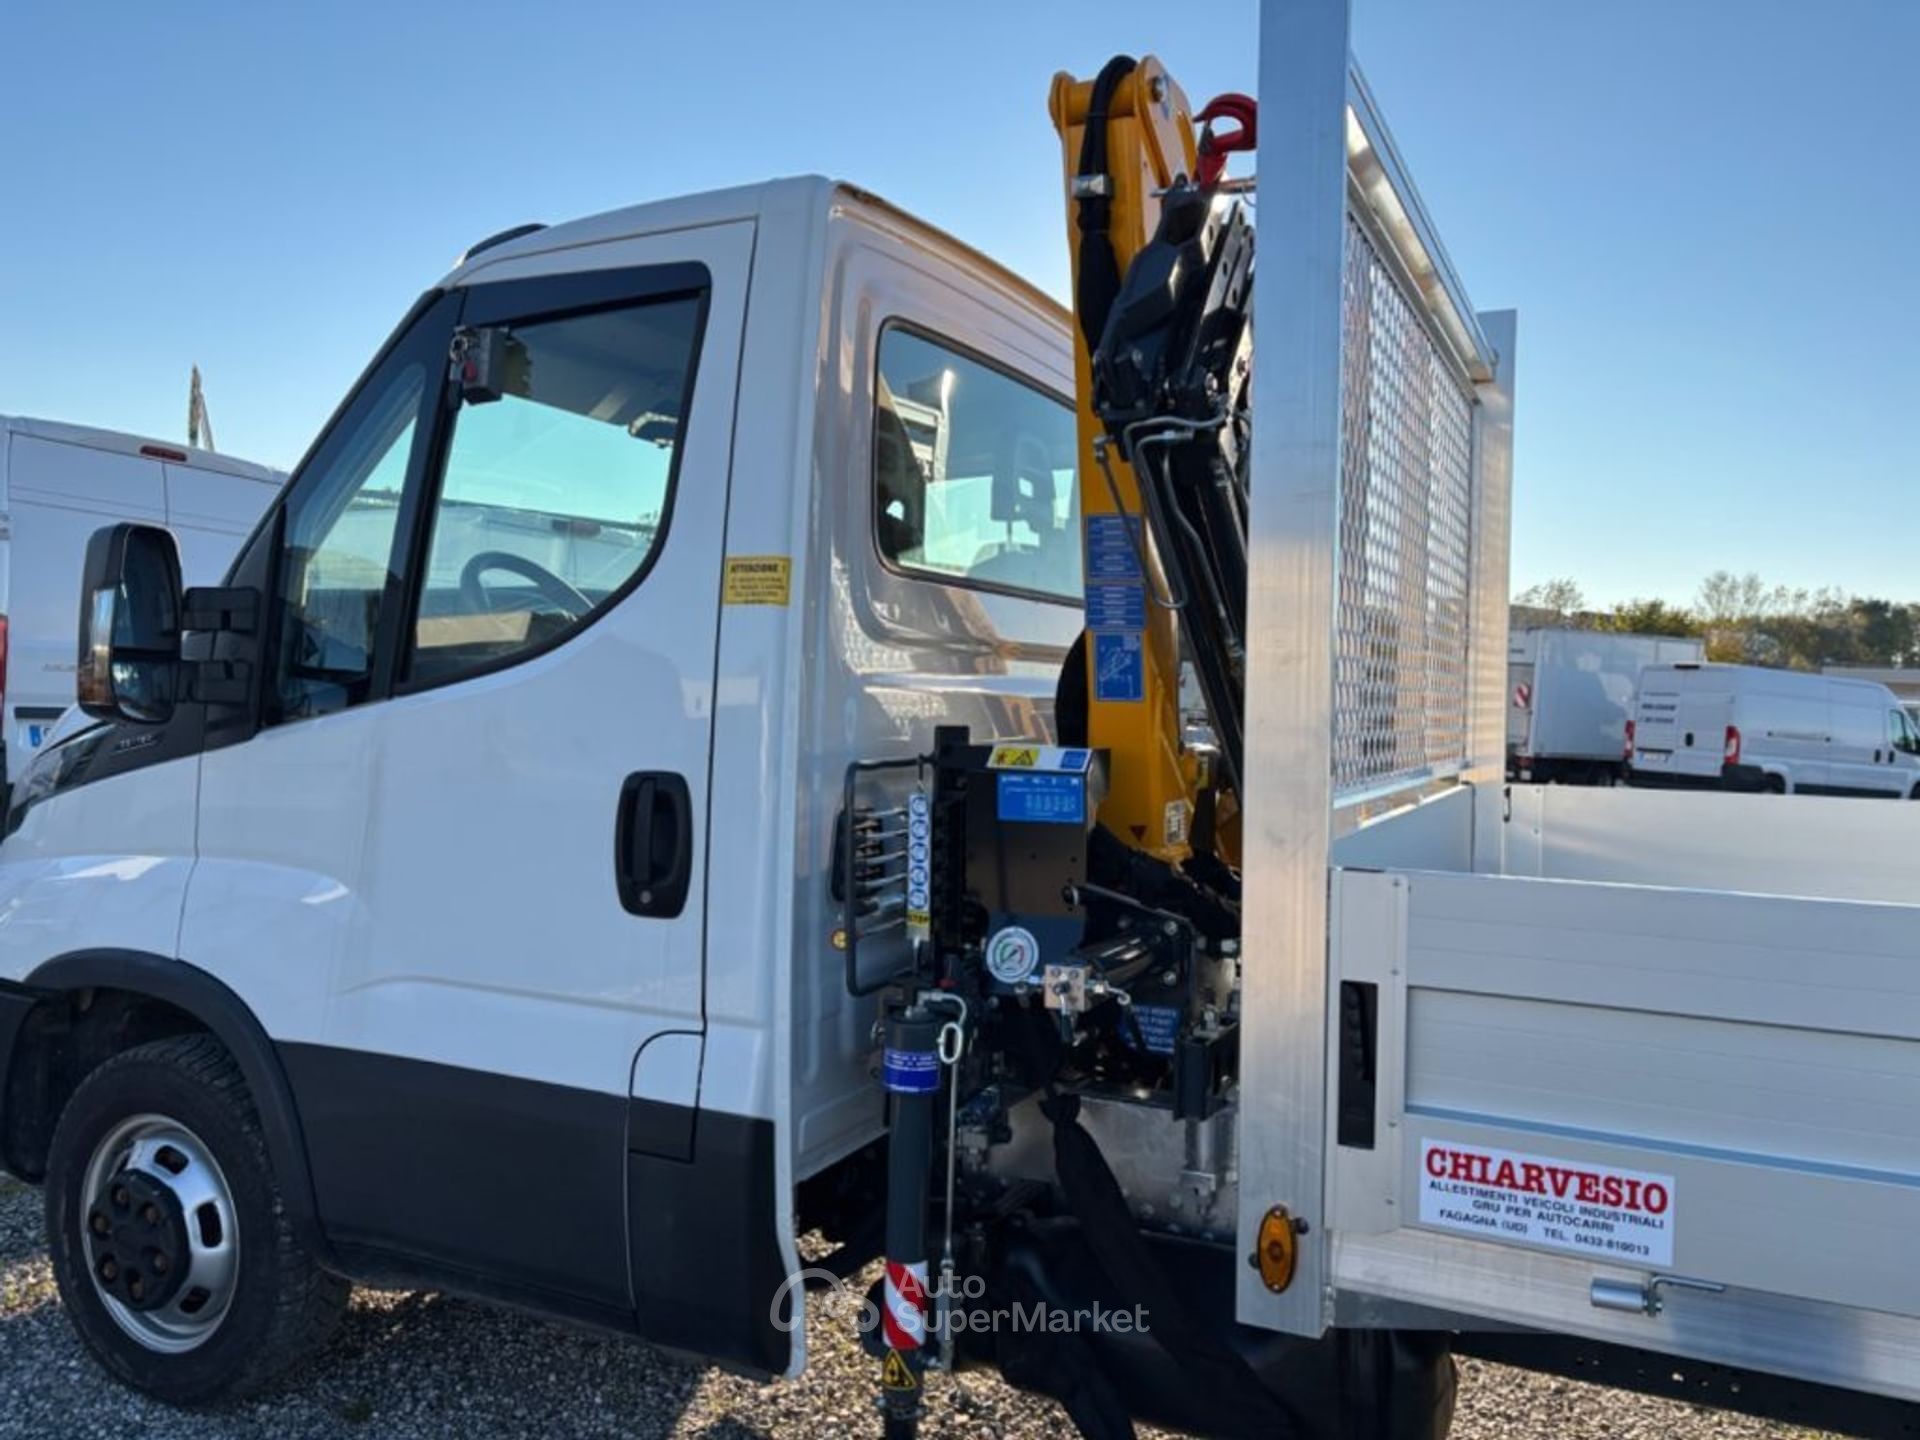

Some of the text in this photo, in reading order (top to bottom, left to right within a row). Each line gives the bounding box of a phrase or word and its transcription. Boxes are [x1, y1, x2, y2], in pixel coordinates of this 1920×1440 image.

[1426, 1148, 1668, 1215] CHIARVESIO
[1429, 1180, 1664, 1230] ALLESTIMENTI VEICOLI INDUSTRIALI
[1439, 1209, 1497, 1229] FAGAGNA
[1501, 1219, 1528, 1236] (UD)
[1543, 1227, 1570, 1242] TEL.
[1472, 1200, 1614, 1233] GRU PER AUTOCARRI
